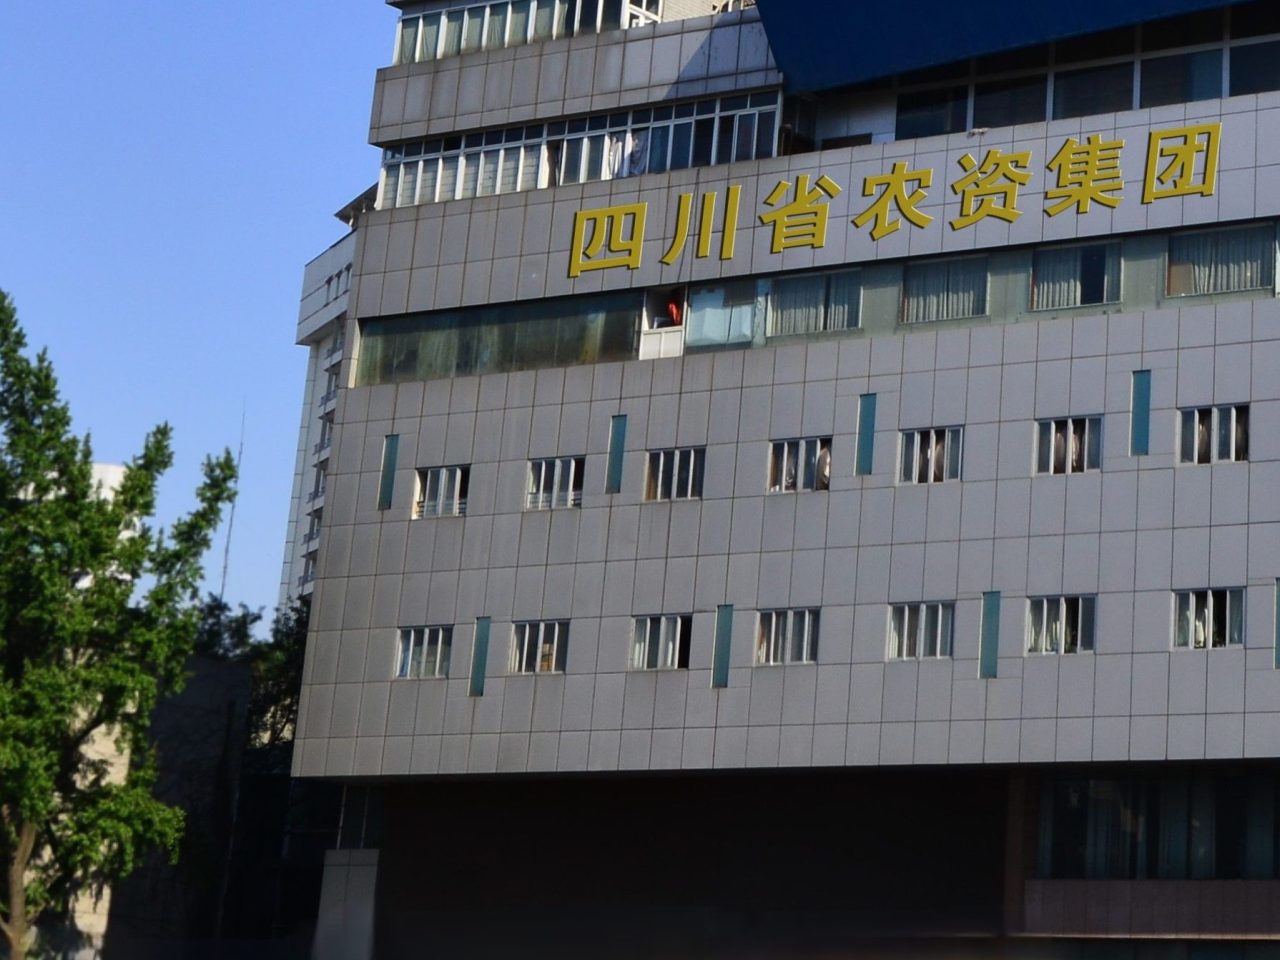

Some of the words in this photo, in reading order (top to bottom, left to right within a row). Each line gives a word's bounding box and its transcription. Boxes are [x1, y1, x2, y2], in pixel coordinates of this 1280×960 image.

[568, 122, 1223, 278] 四川省农资集团
